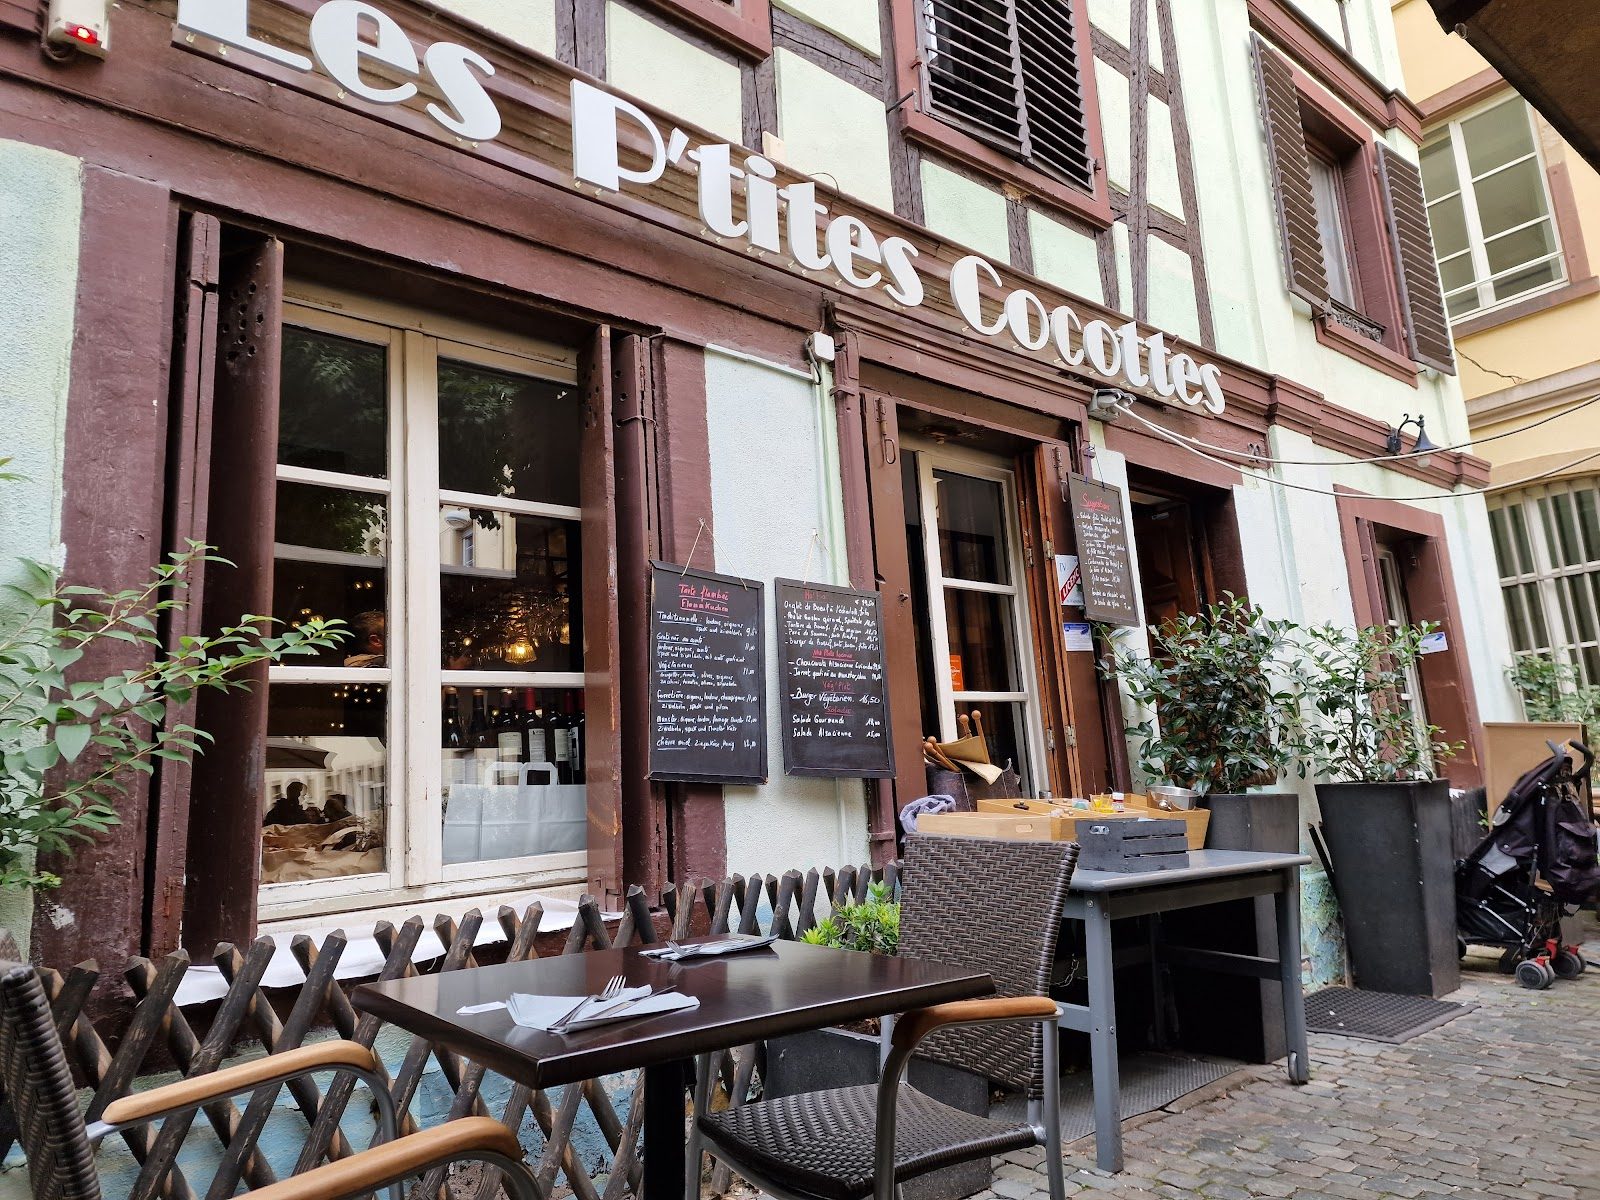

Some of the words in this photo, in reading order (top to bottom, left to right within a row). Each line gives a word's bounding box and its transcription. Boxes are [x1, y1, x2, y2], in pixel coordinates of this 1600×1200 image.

[177, 0, 502, 141] Les
[570, 78, 924, 307] P'tites
[949, 255, 1227, 415] Cocottes
[1062, 566, 1081, 598] LICENC
